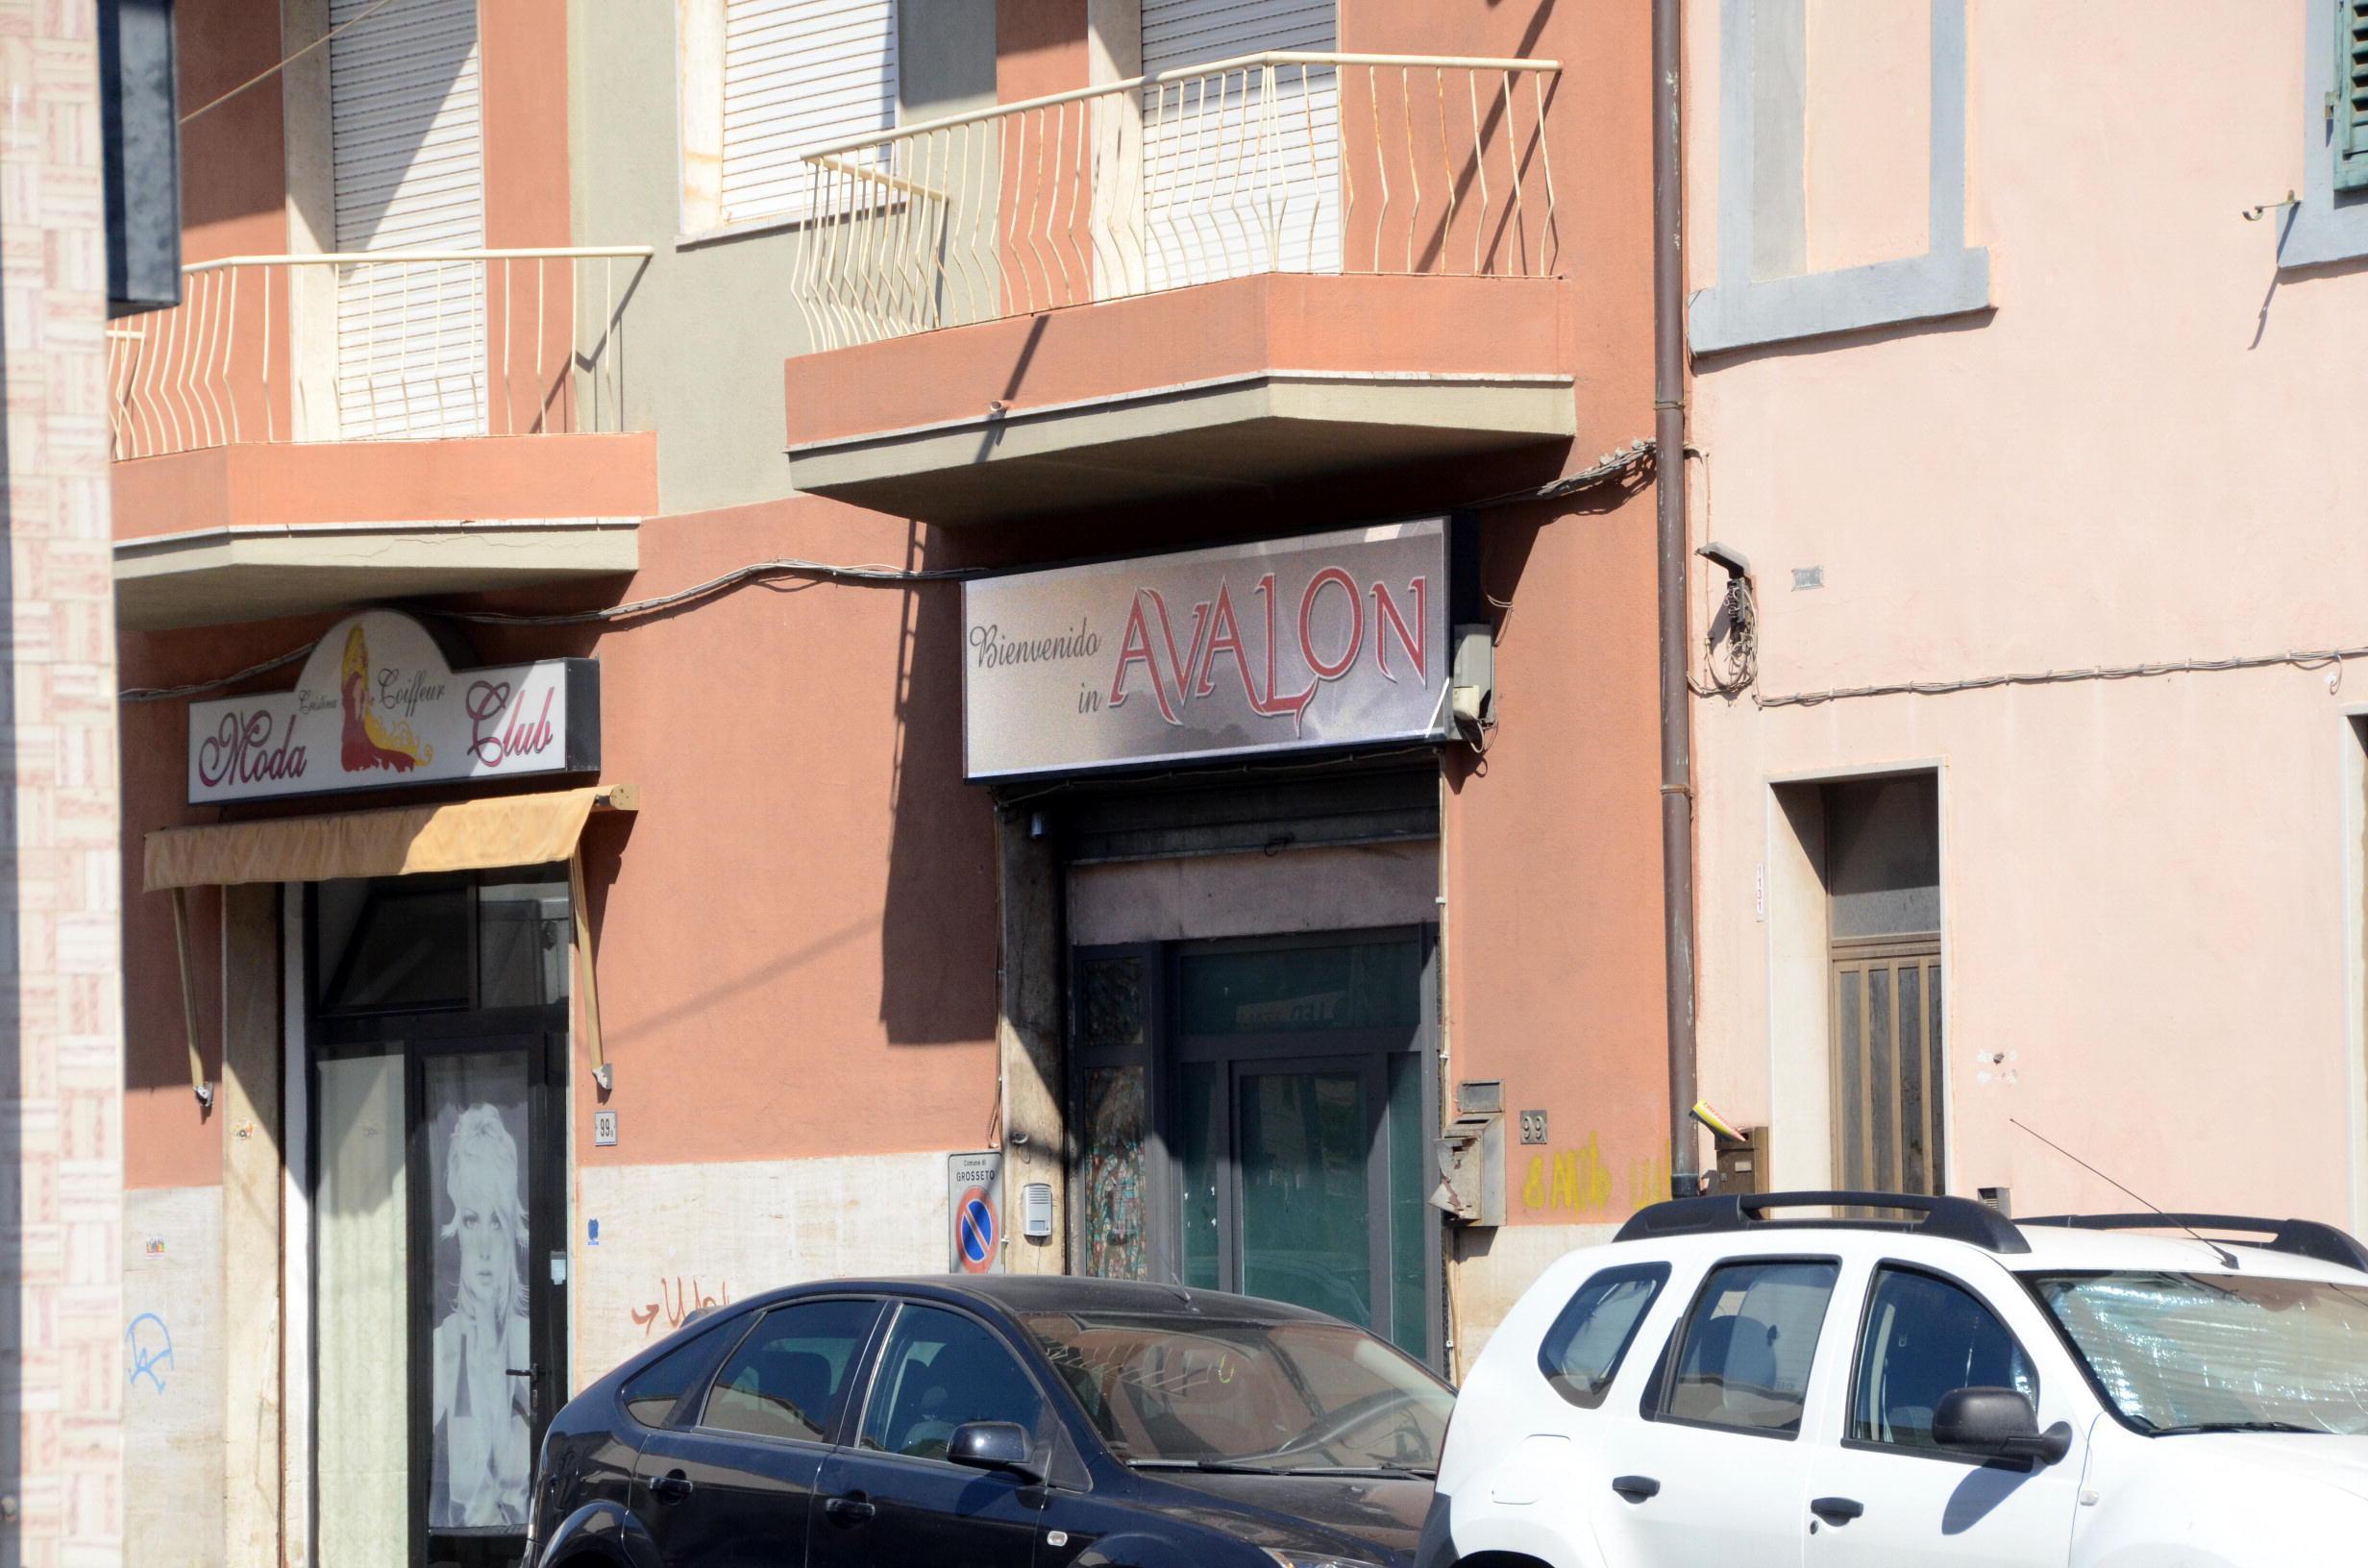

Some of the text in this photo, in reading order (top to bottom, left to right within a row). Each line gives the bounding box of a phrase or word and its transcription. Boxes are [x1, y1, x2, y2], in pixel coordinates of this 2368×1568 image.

[969, 617, 1102, 669] Bienvenido
[1108, 565, 1428, 739] AVALON
[378, 668, 446, 718] Coiffeur
[1077, 682, 1102, 715] in
[198, 679, 555, 788] Moda Club
[956, 1169, 996, 1182] GROSSETO
